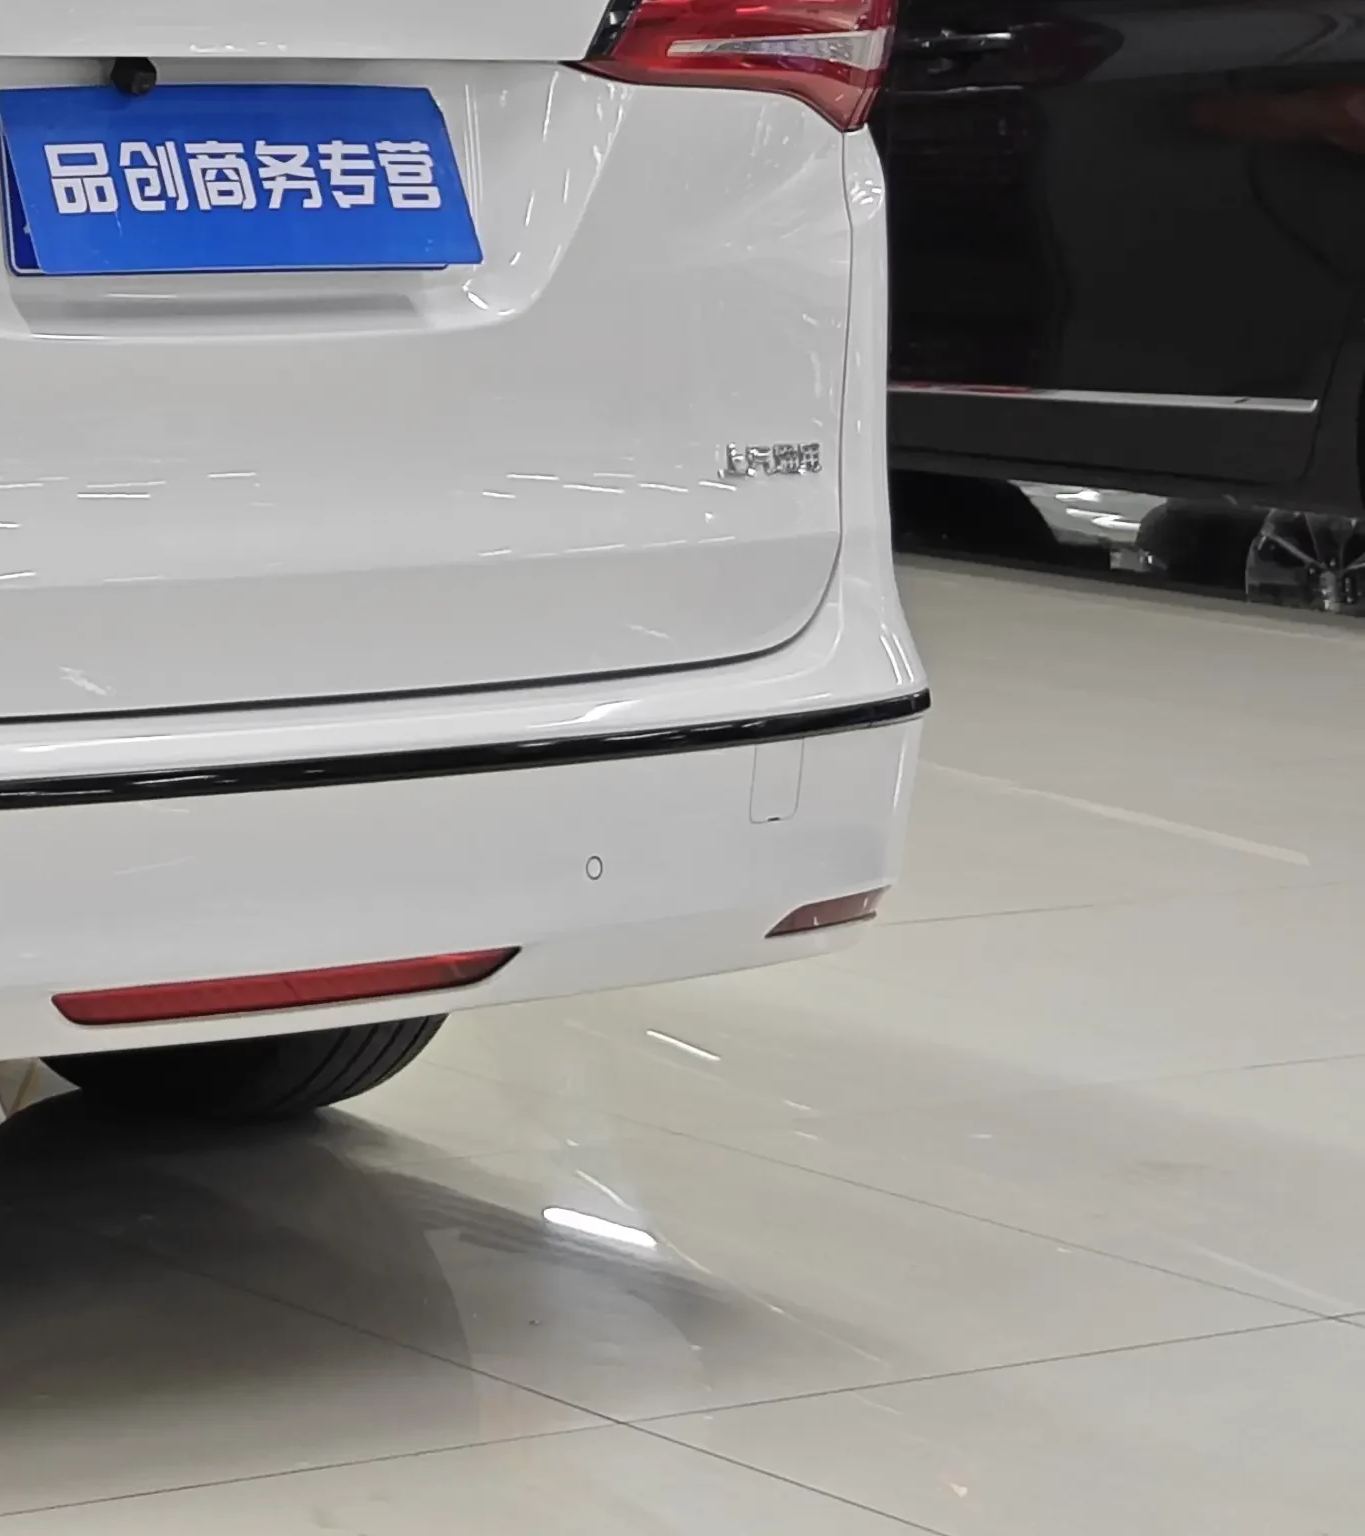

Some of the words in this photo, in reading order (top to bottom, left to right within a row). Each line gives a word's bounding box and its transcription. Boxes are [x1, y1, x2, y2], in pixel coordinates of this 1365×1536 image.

[43, 139, 443, 215] 品创商务专营
